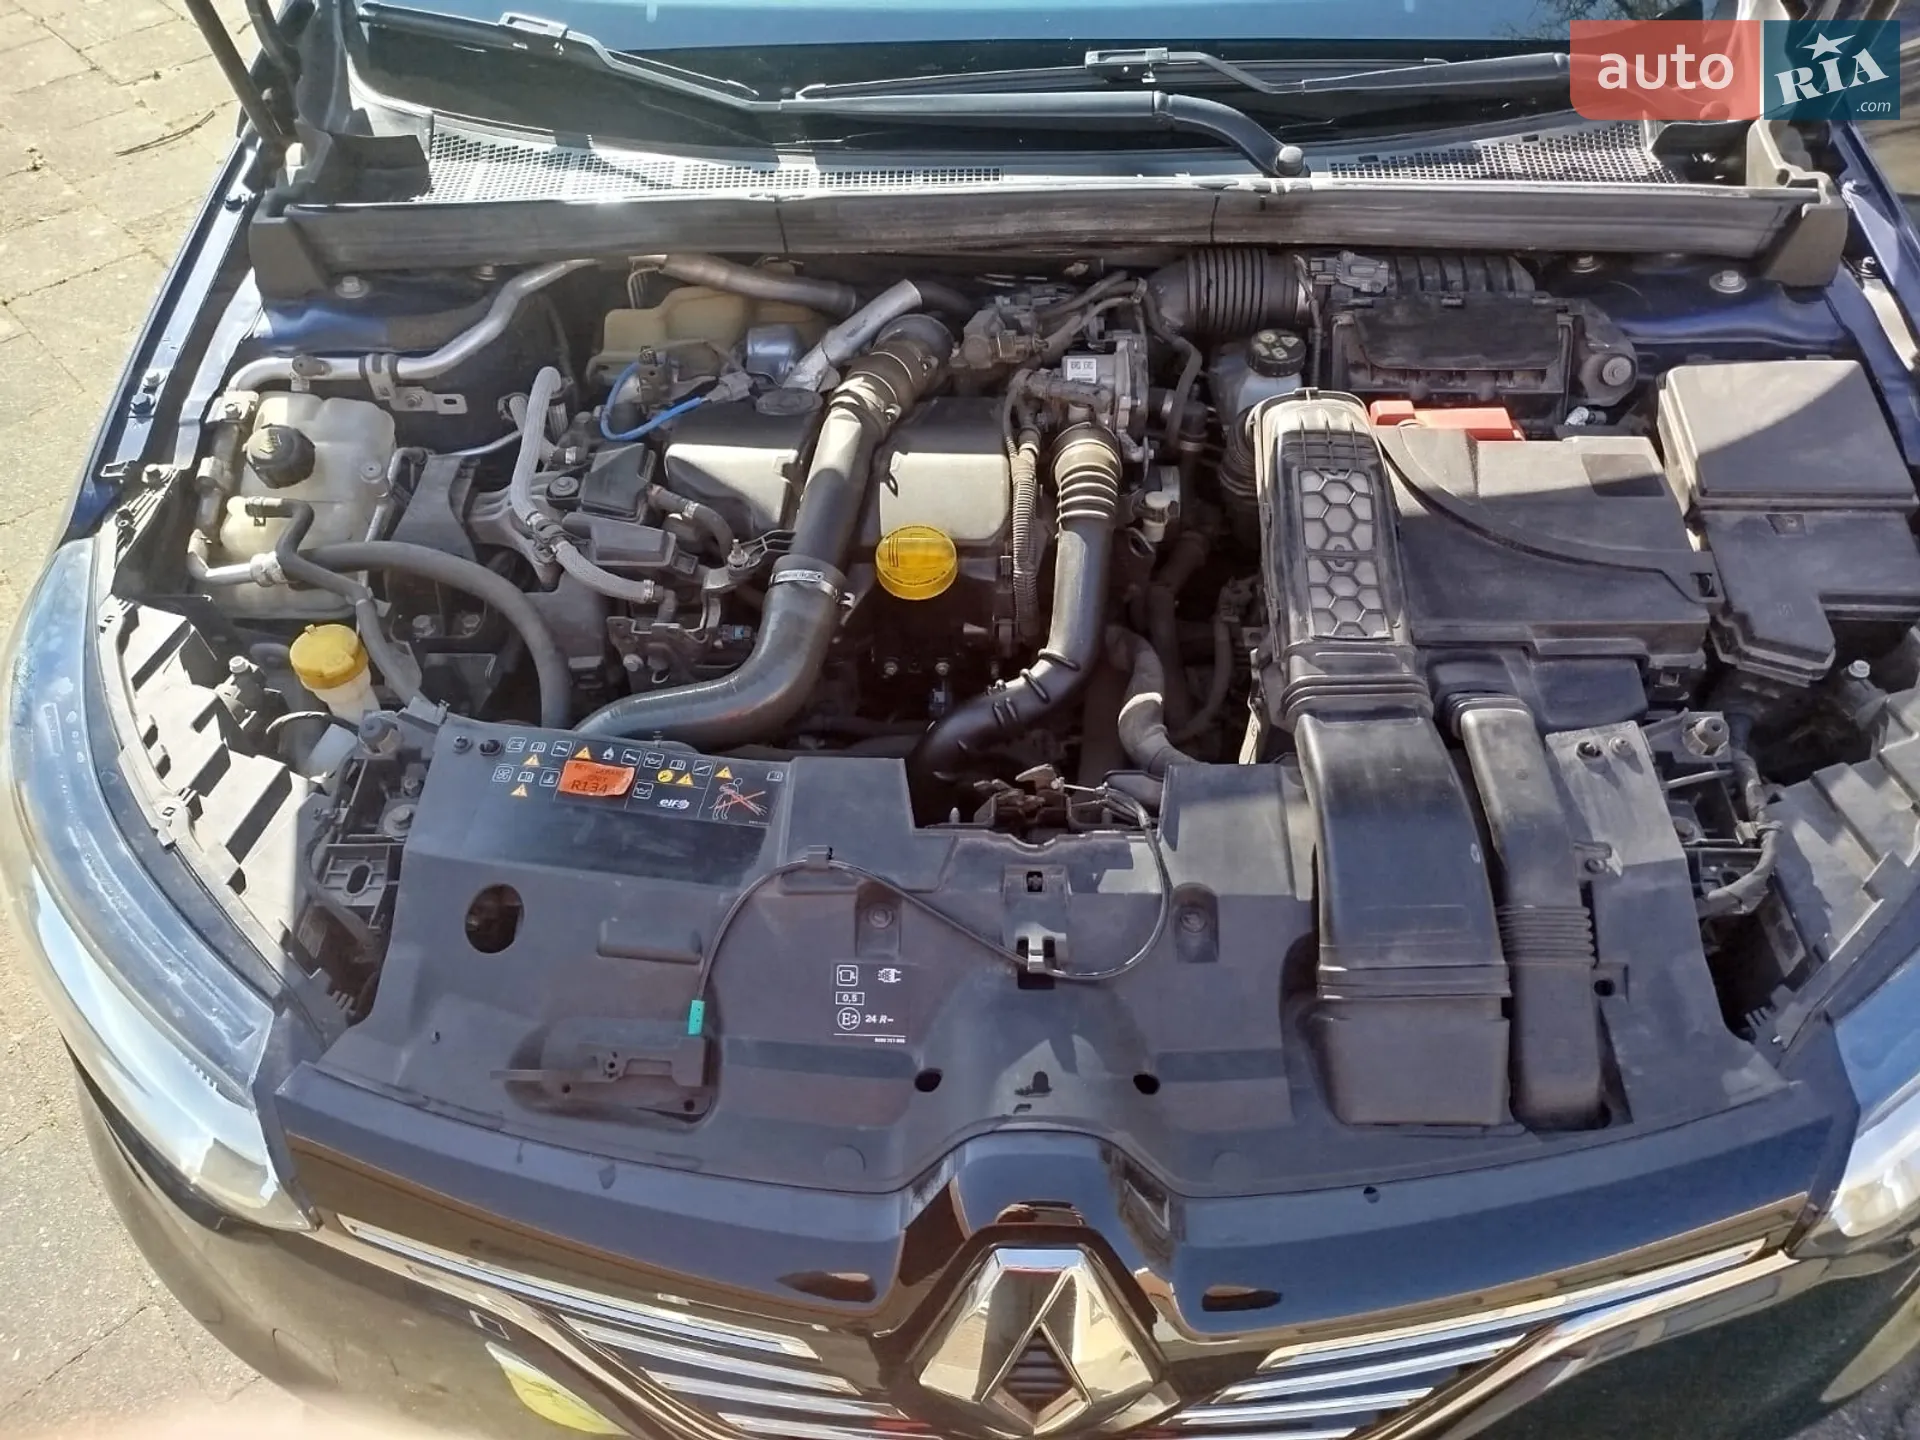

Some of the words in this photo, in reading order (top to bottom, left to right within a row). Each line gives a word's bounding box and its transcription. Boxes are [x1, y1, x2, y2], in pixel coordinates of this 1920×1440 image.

[659, 799, 681, 809] elf
[842, 1012, 858, 1025] E2
[865, 1014, 876, 1023] 24
